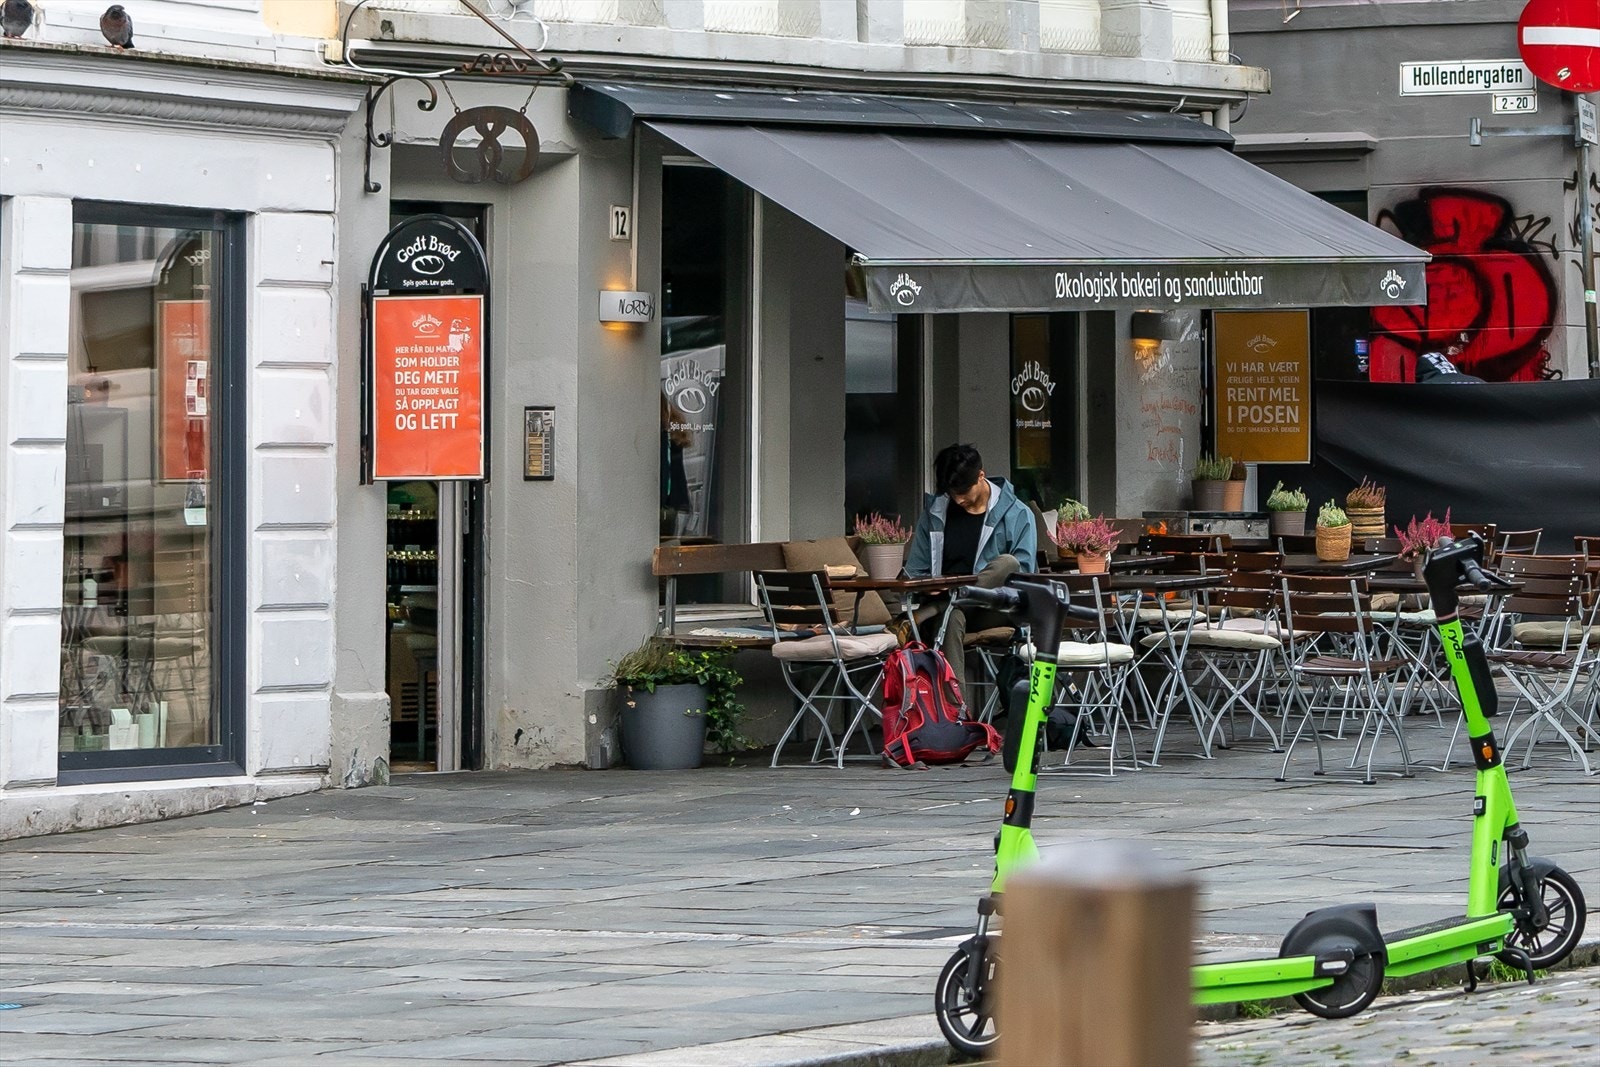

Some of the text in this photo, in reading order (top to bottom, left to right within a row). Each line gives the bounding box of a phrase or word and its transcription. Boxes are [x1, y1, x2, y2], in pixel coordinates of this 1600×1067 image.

[1413, 64, 1523, 89] Hollendergaten
[1502, 98, 1508, 109] 2
[1516, 97, 1529, 109] 20
[614, 210, 627, 236] 12
[397, 235, 461, 263] Godt Brød
[402, 279, 415, 288] Spis
[414, 279, 430, 288] godt.
[440, 278, 455, 287] godt.
[890, 272, 922, 296] Godt Brød
[1054, 270, 1264, 303] Økologisk bakeri og sandwichbar
[395, 346, 409, 354] HER
[410, 344, 424, 354] FÅR
[395, 356, 460, 368] SOM HOLDER
[1226, 361, 1300, 373] VI HAR VÆRT
[394, 370, 460, 385] DEG METT
[665, 359, 720, 397] Godt Brød
[1011, 360, 1056, 397] Godt Brød
[1226, 375, 1300, 384] ÆRLIGE HELE VEIEN
[395, 387, 459, 396] DU TAR GODE VALG
[1227, 387, 1300, 402] RENT MEL
[395, 395, 459, 411] SÅ OPPLAGT
[395, 412, 459, 431] OG LETT
[1227, 404, 1300, 424] I POSEN
[670, 421, 681, 431] Spis
[1447, 628, 1464, 660] ryde
[1030, 666, 1042, 704] ryde
